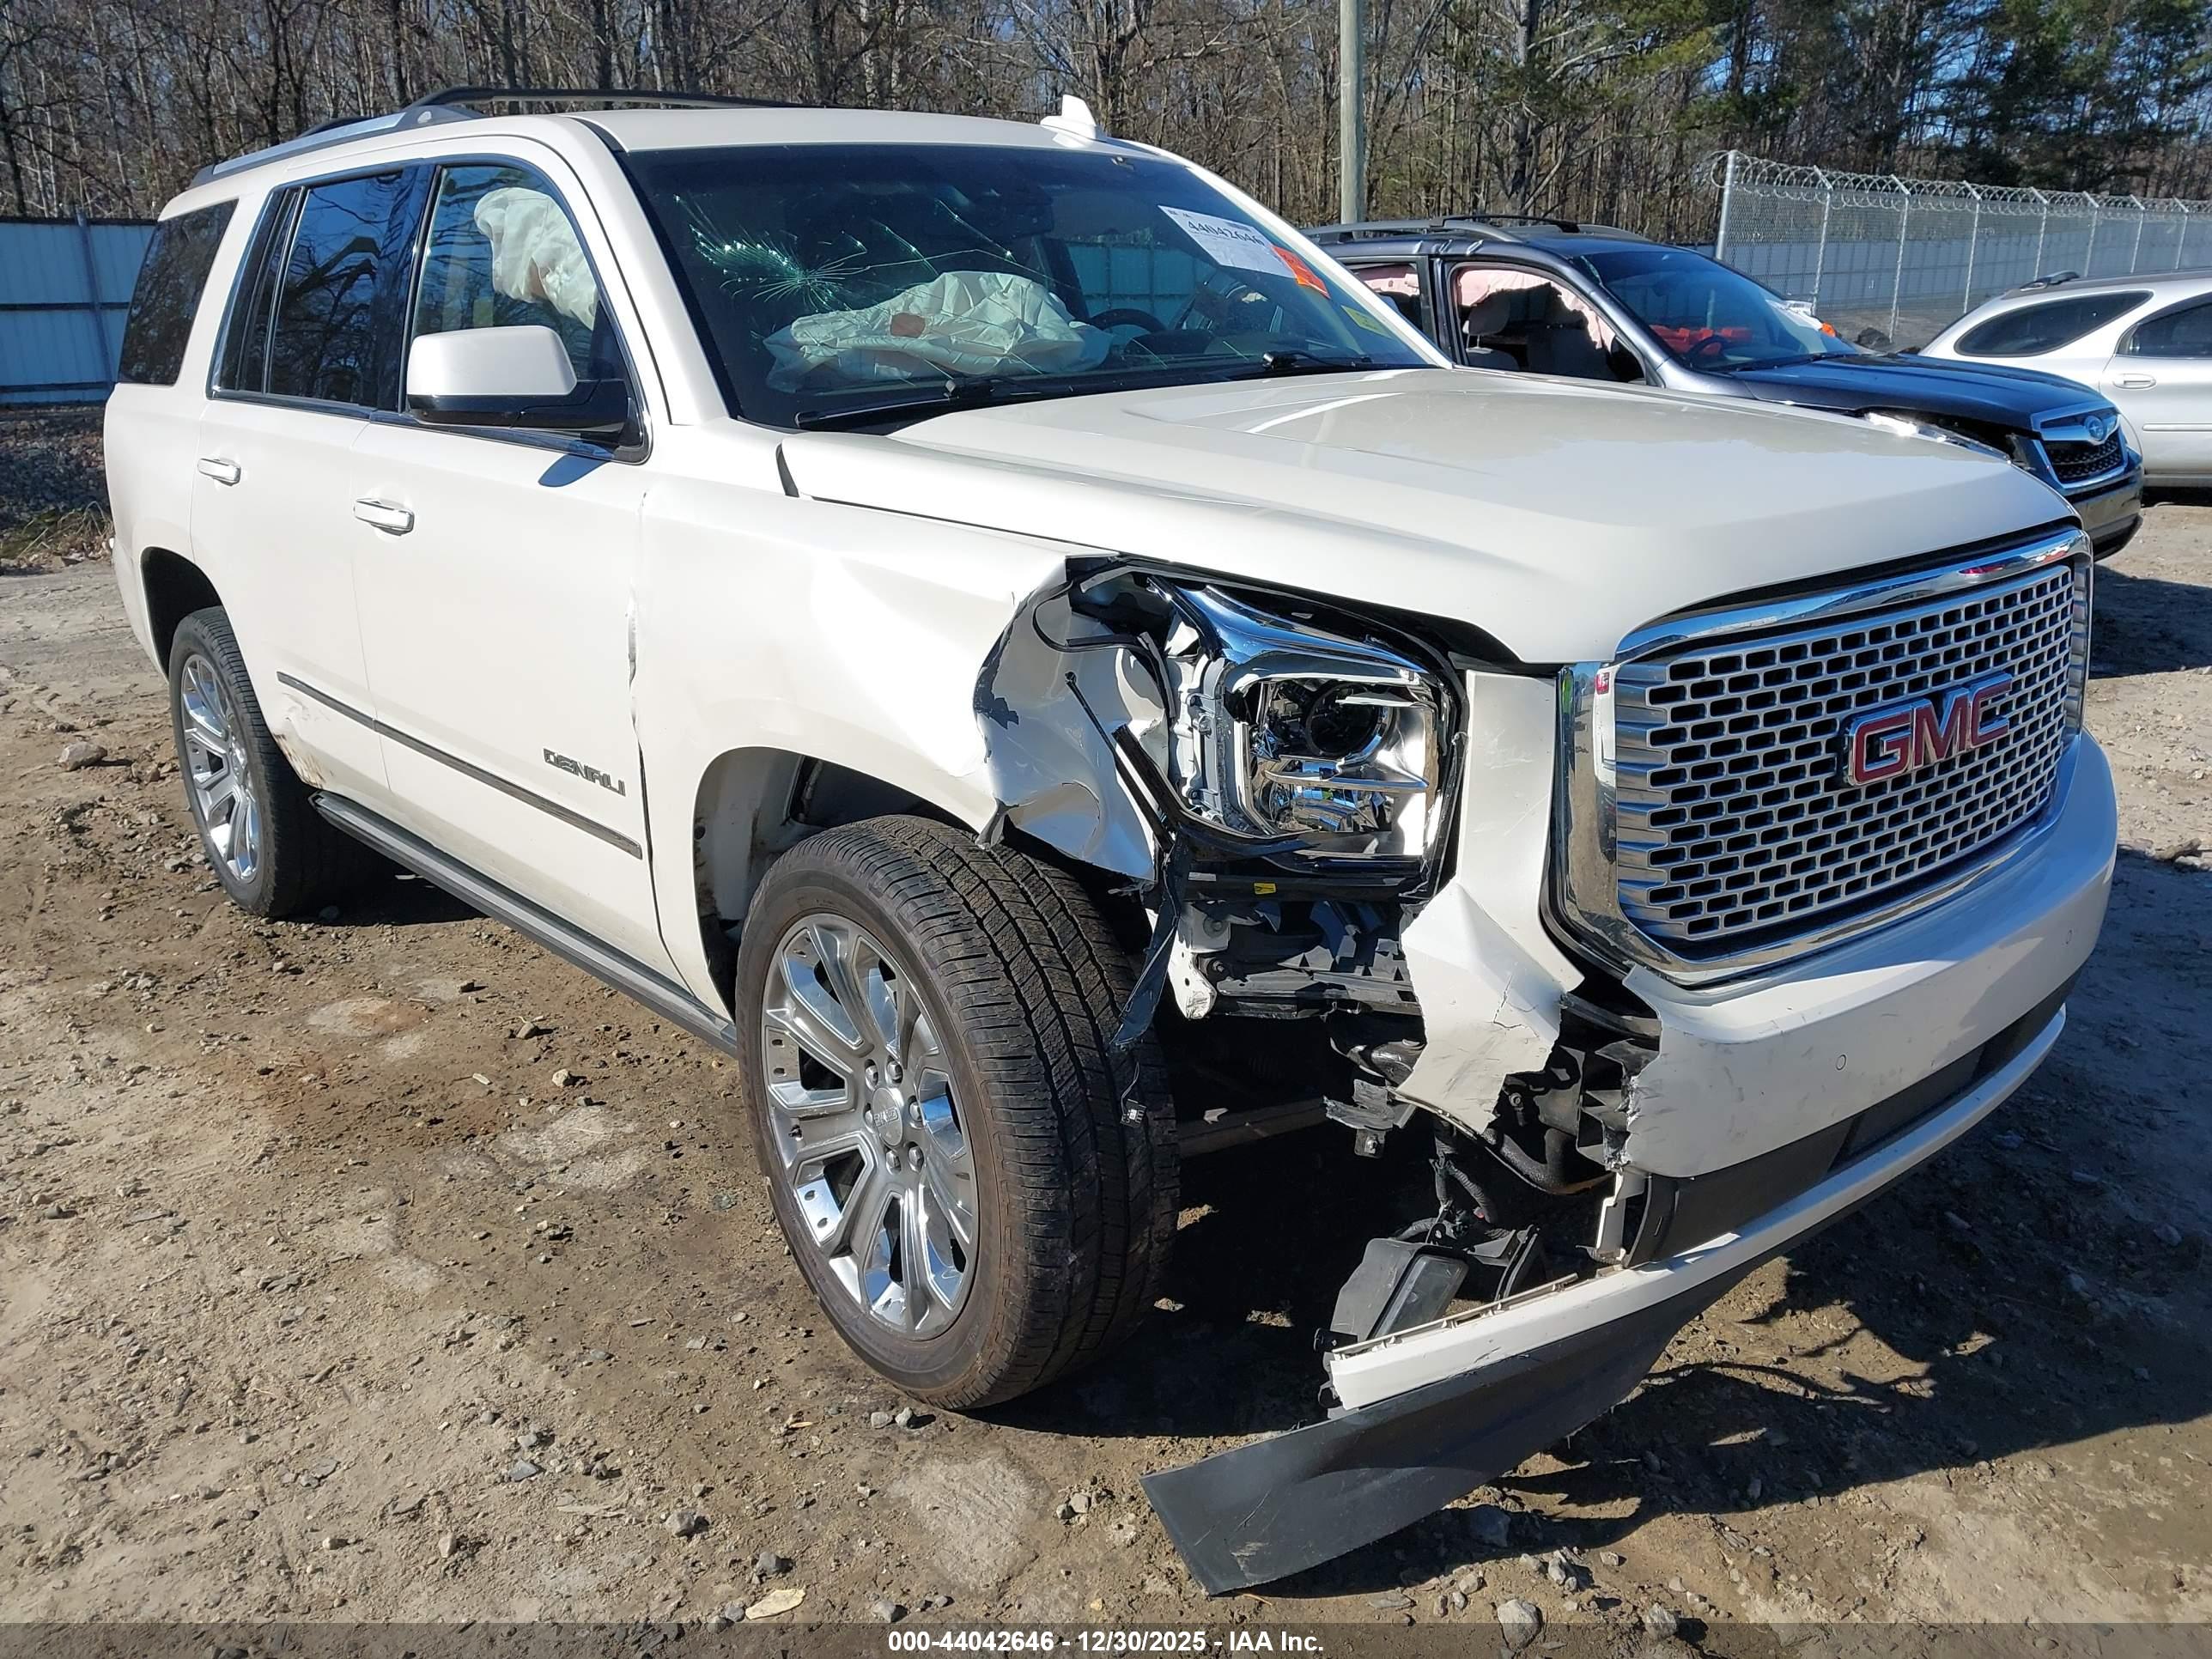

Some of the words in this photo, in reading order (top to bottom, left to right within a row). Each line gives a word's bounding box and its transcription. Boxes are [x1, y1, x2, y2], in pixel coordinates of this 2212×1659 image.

[1188, 221, 1266, 246] 44042646
[1848, 671, 2013, 786] GMC
[543, 748, 626, 797] DENALI
